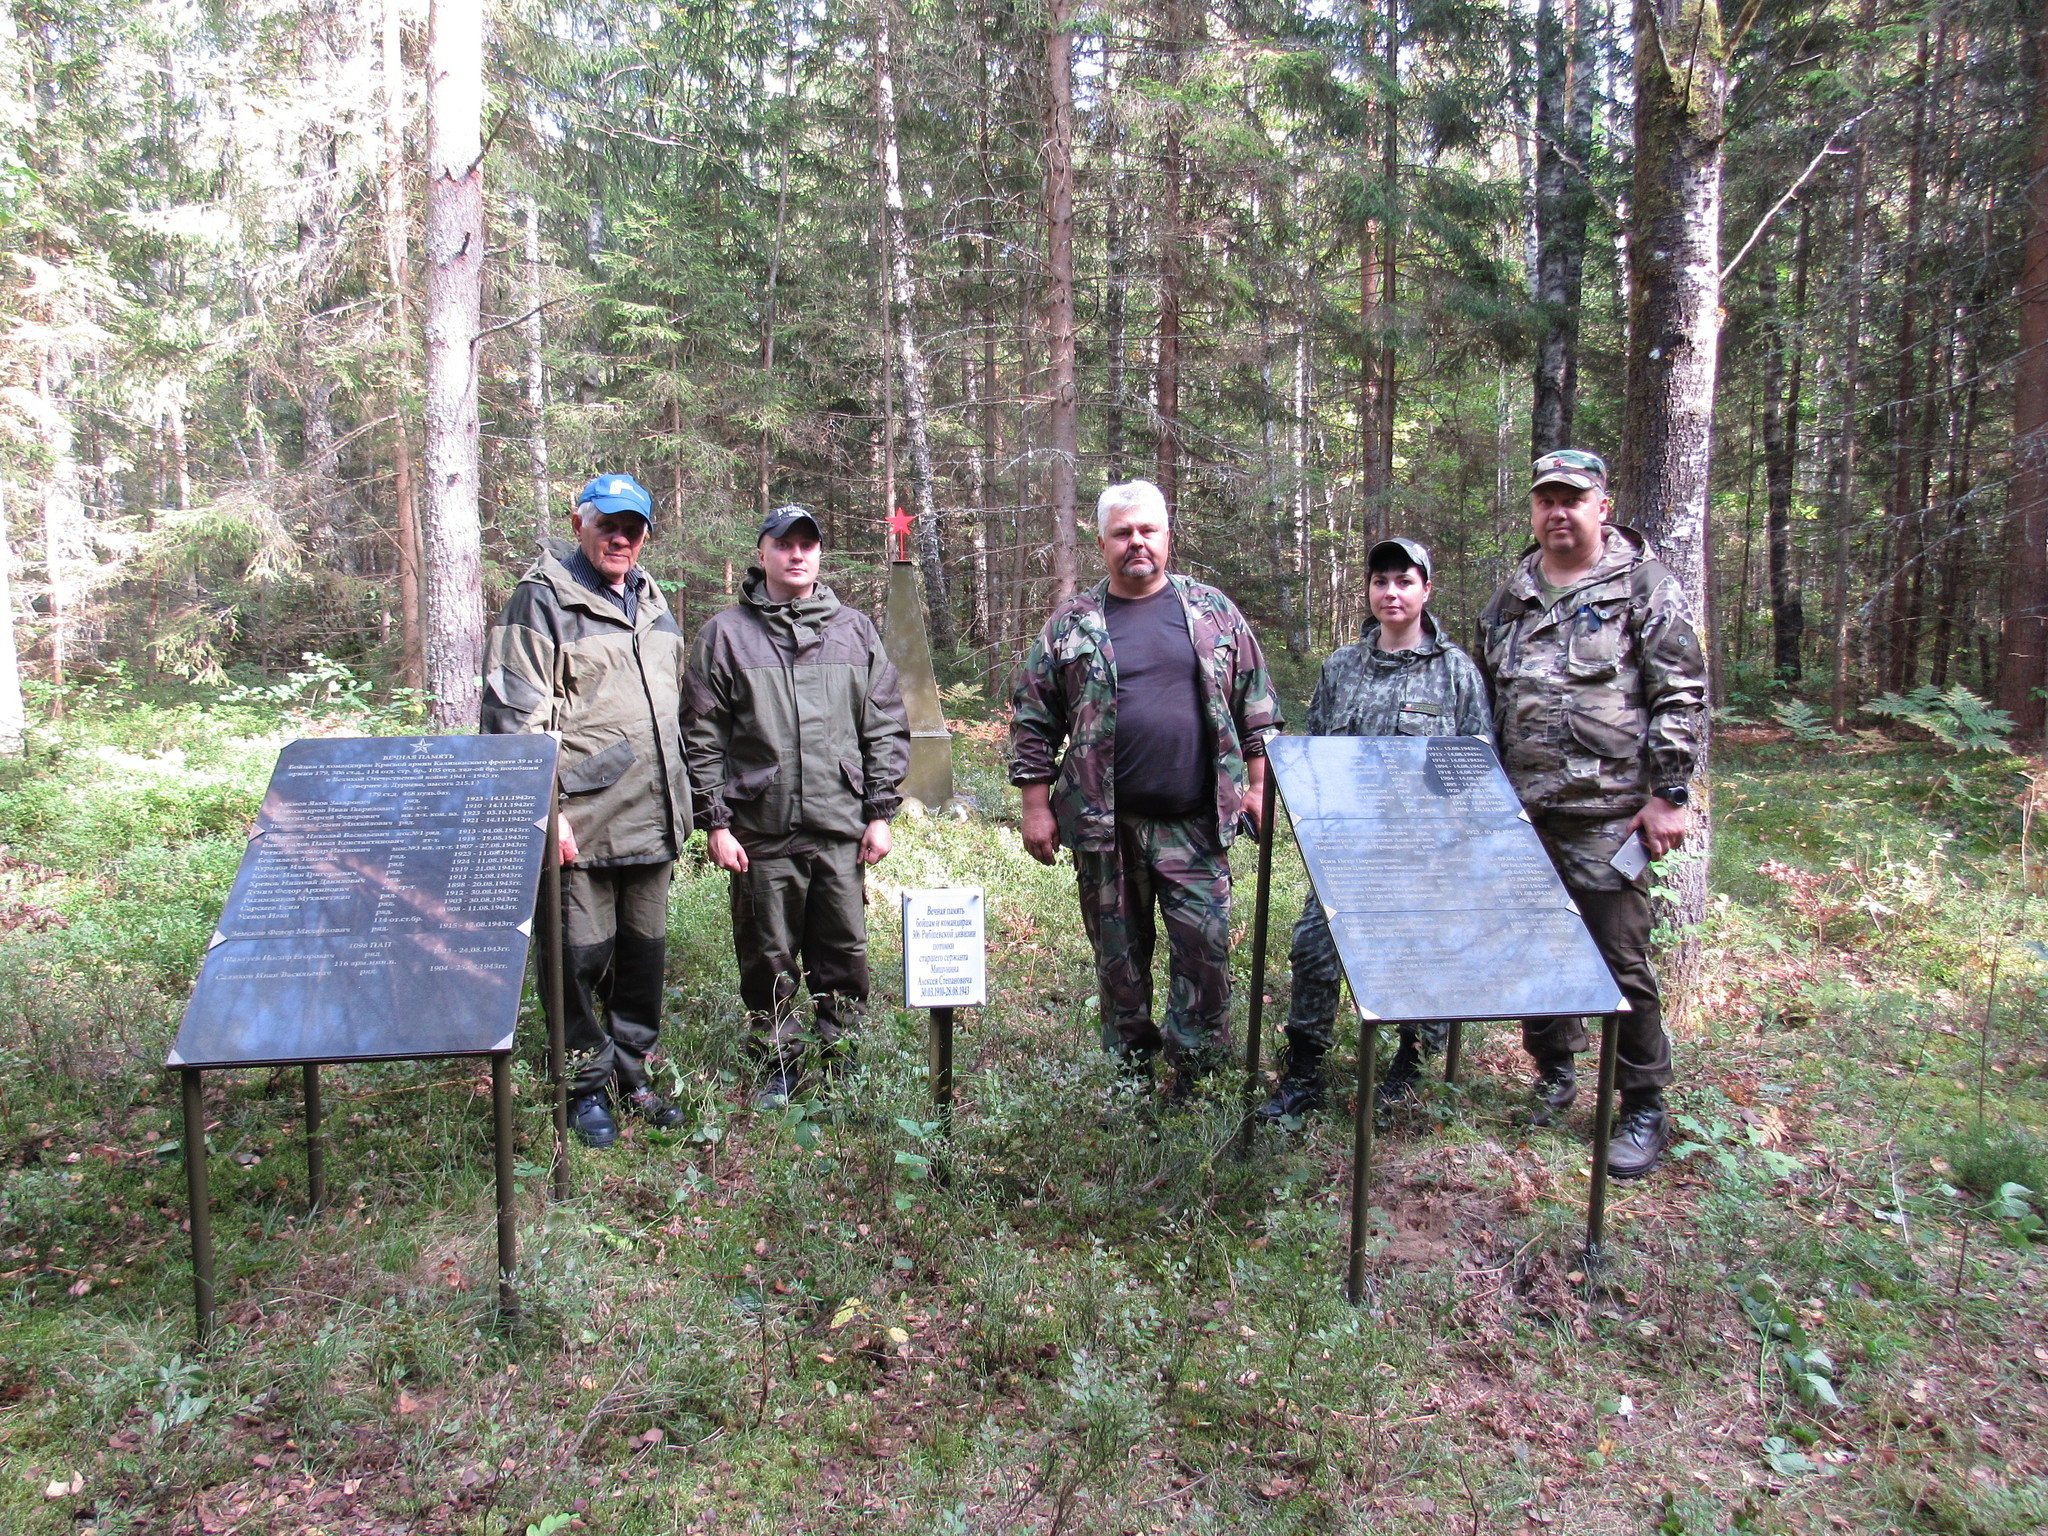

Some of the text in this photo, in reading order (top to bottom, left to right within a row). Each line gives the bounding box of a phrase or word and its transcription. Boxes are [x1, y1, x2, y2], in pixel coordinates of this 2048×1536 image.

[325, 762, 373, 770] командирам
[432, 758, 487, 766] Калининского
[365, 774, 424, 782] Отечественной
[335, 812, 381, 821] Федорович
[341, 819, 393, 827] Михайлович
[342, 830, 390, 838] Васильевич
[336, 837, 405, 846] Константинович
[305, 869, 358, 878] Григорьевич
[280, 878, 318, 886] Николай
[318, 876, 366, 885] Данилович
[273, 887, 302, 895] Федор
[927, 905, 965, 916] Вечная память
[940, 919, 972, 930] командирам
[266, 928, 295, 937] Федор
[918, 953, 969, 966] старшего сержанта
[917, 975, 972, 986] Алексея Степановича
